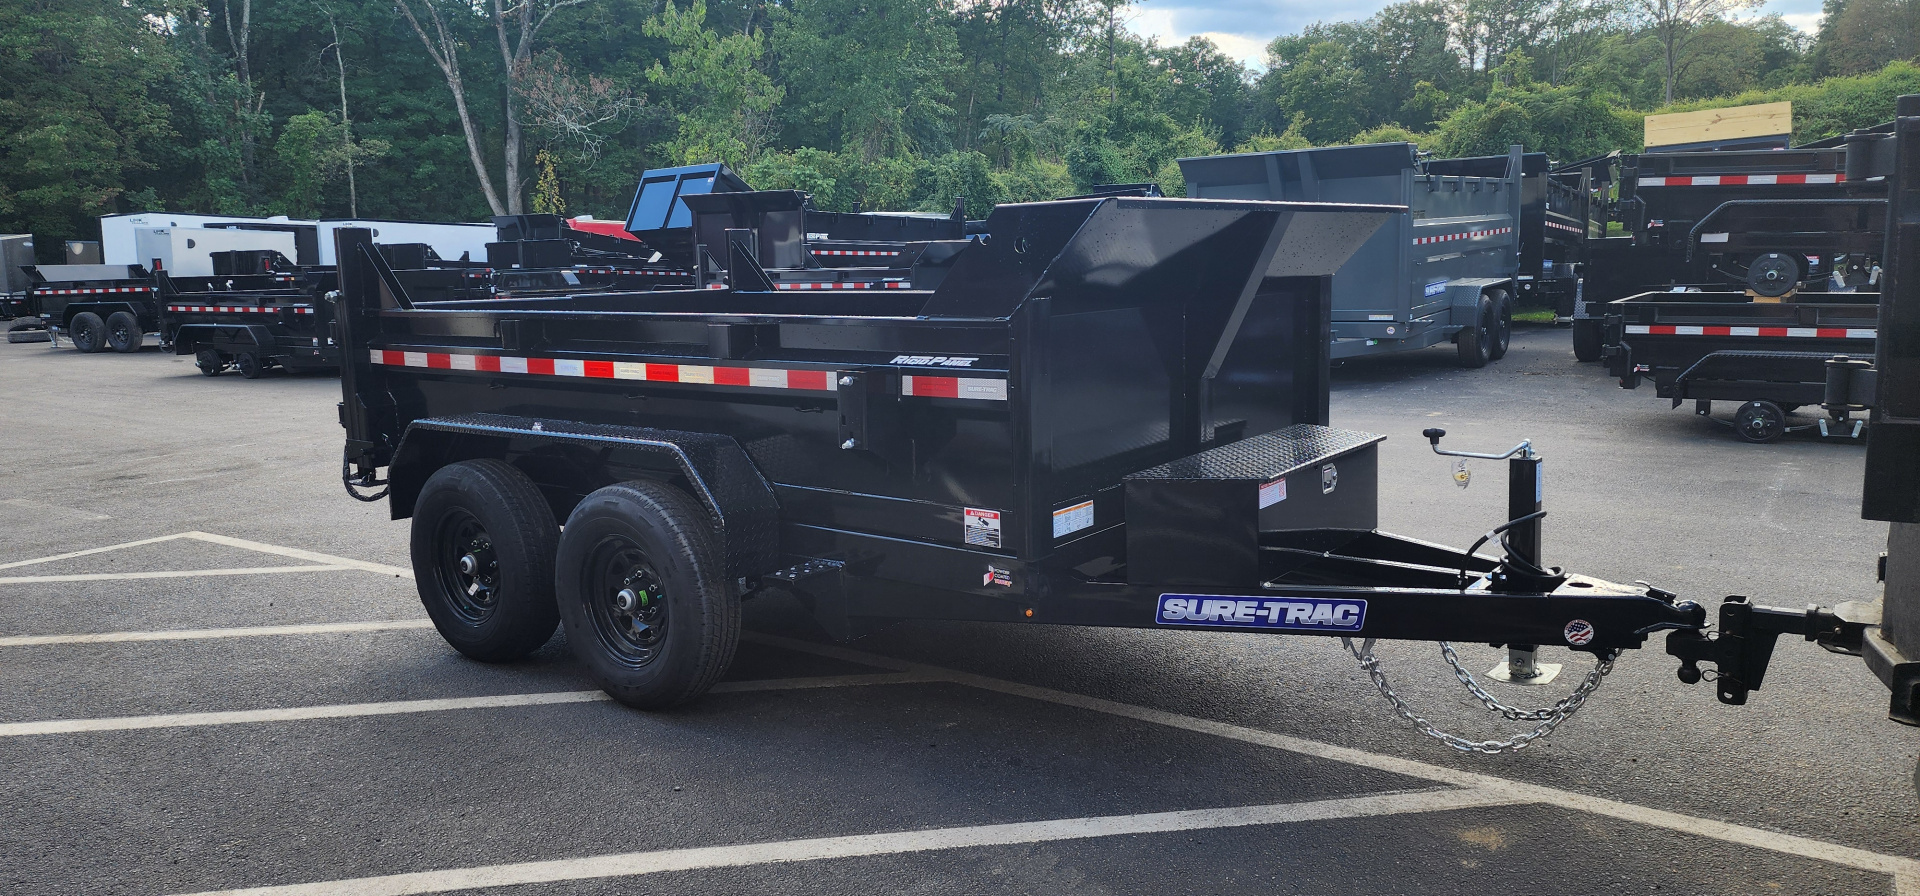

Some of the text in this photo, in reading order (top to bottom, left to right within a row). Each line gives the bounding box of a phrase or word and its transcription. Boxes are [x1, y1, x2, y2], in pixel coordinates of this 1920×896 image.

[927, 356, 980, 367] PANEL
[967, 386, 998, 394] SURE-TRAC
[974, 510, 995, 519] DANGER
[1162, 599, 1361, 627] SURE-TRAC
